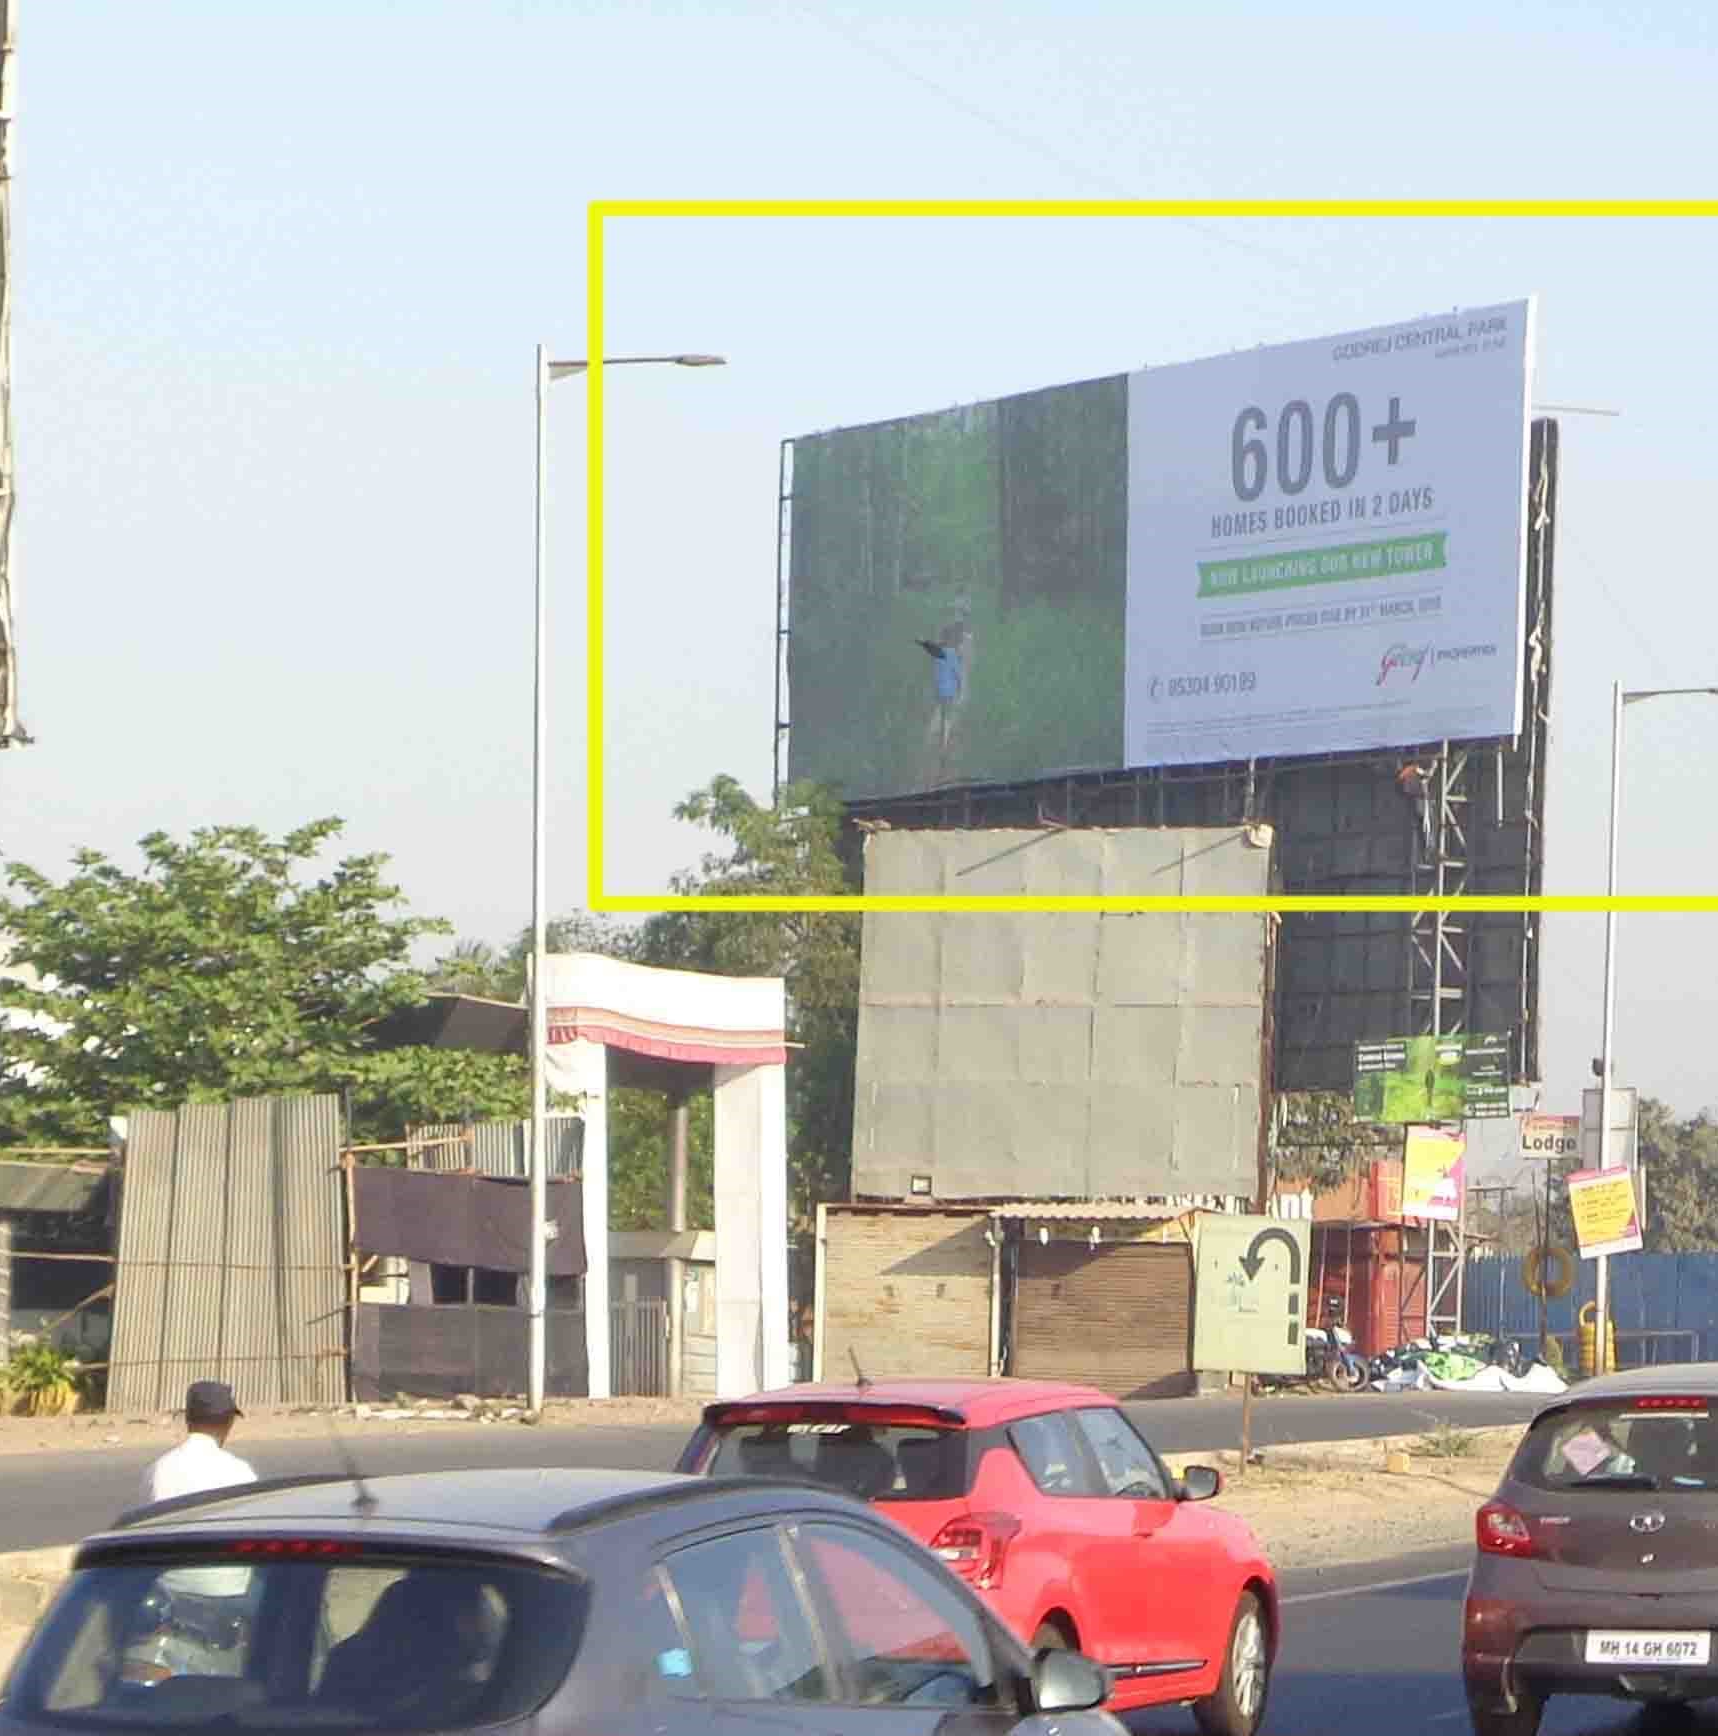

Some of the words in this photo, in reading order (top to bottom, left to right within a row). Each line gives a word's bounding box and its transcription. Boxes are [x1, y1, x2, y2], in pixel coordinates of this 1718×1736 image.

[1395, 327, 1462, 352] CENTRAL
[1231, 391, 1416, 501] 600+
[1211, 508, 1268, 538] HOMES
[1275, 499, 1341, 530] BOOKED
[1349, 497, 1366, 521] IN
[1372, 495, 1383, 519] 2
[1388, 487, 1434, 514] DAYS
[1523, 1134, 1577, 1154] Lodge
[1599, 1640, 1620, 1656] MH
[1625, 1641, 1639, 1656] 14
[1666, 1641, 1698, 1657] 6072
